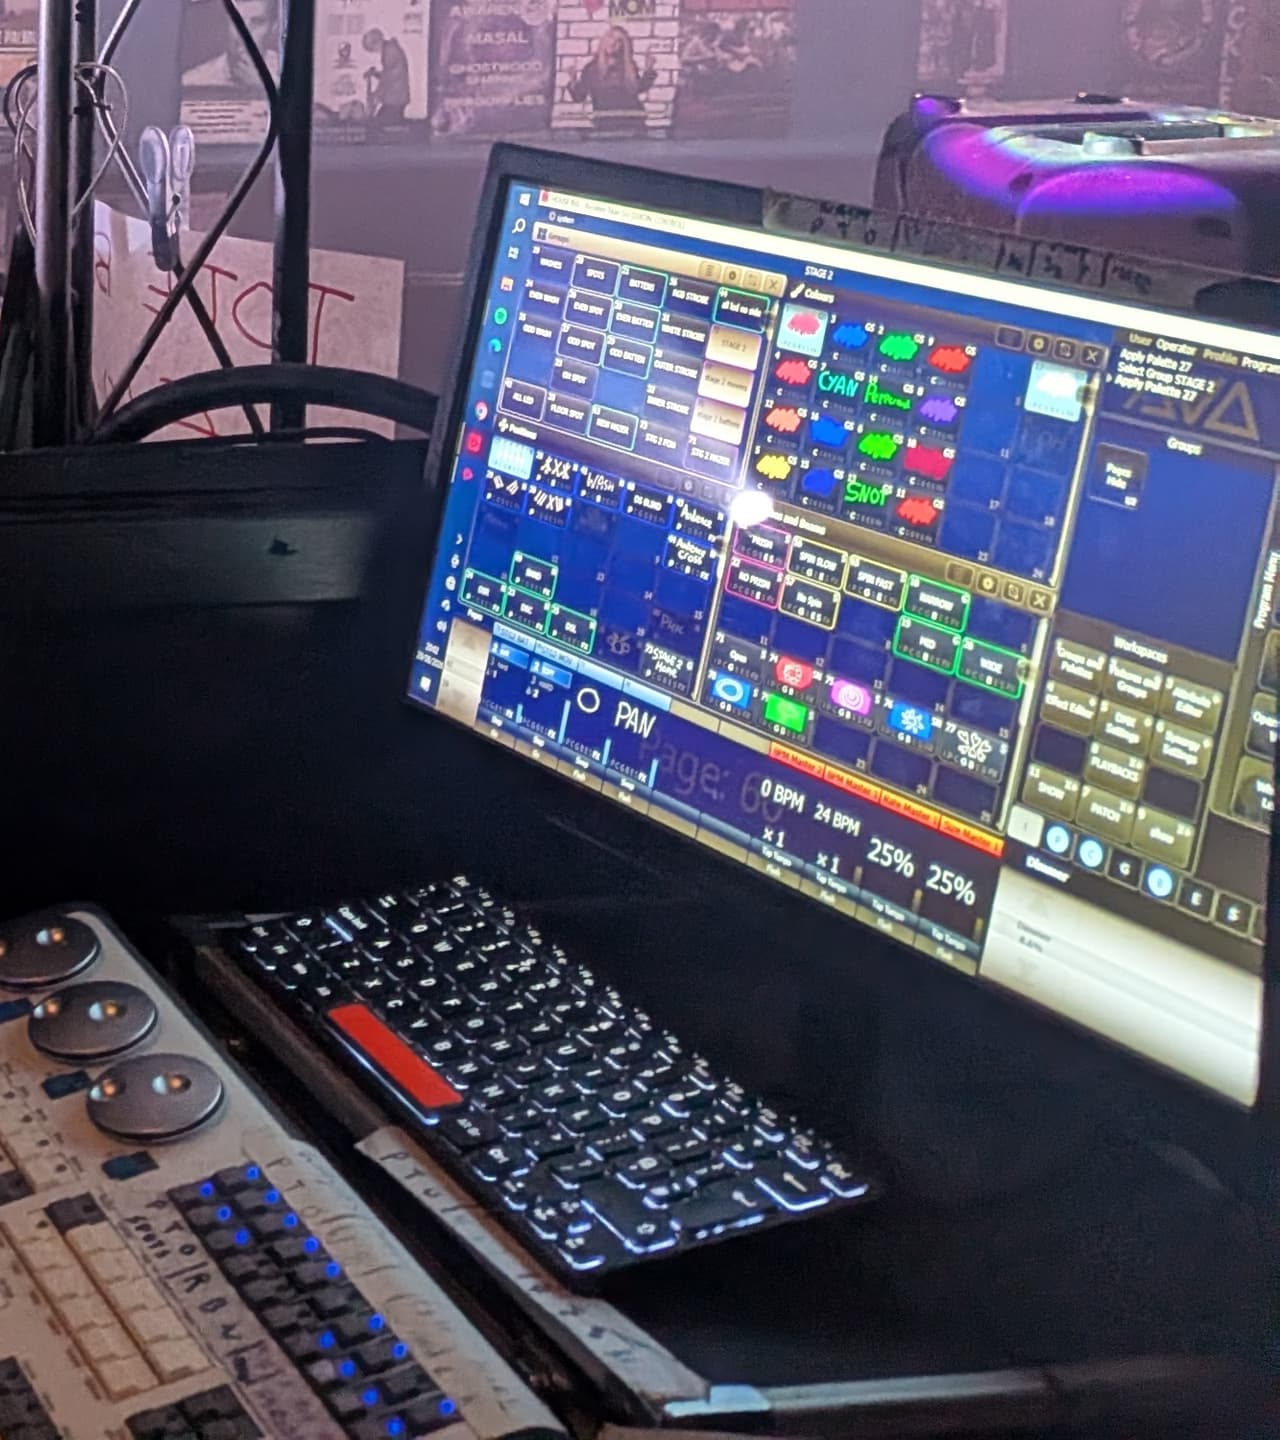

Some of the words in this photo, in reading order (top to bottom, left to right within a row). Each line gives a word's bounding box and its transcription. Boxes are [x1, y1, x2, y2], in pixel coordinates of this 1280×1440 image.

[804, 265, 827, 279] STAGE
[804, 287, 836, 304] Colours
[1120, 348, 1146, 366] Apply
[1146, 353, 1178, 371] Palette
[1179, 360, 1193, 373] 27
[1129, 332, 1154, 347] User
[1156, 338, 1199, 357] Operator
[1203, 348, 1240, 366] Profile
[818, 369, 860, 398] CYAN
[1114, 374, 1143, 392] Apply
[1144, 380, 1182, 398] Palette
[1182, 390, 1198, 403] 27
[1117, 361, 1144, 377] Select
[1146, 368, 1173, 385] Group
[1175, 375, 1207, 392] STAGE
[1166, 436, 1203, 456] Groups
[844, 480, 889, 508] SNOT
[613, 700, 657, 739] PAN
[1090, 756, 1140, 784] PLAYBACKS
[760, 778, 771, 798] 0
[773, 782, 805, 813] BPM
[813, 802, 831, 823] 24
[831, 809, 861, 837] BPM
[866, 837, 916, 879] 25%
[1025, 855, 1072, 884] Dimmer
[925, 863, 977, 907] 25%
